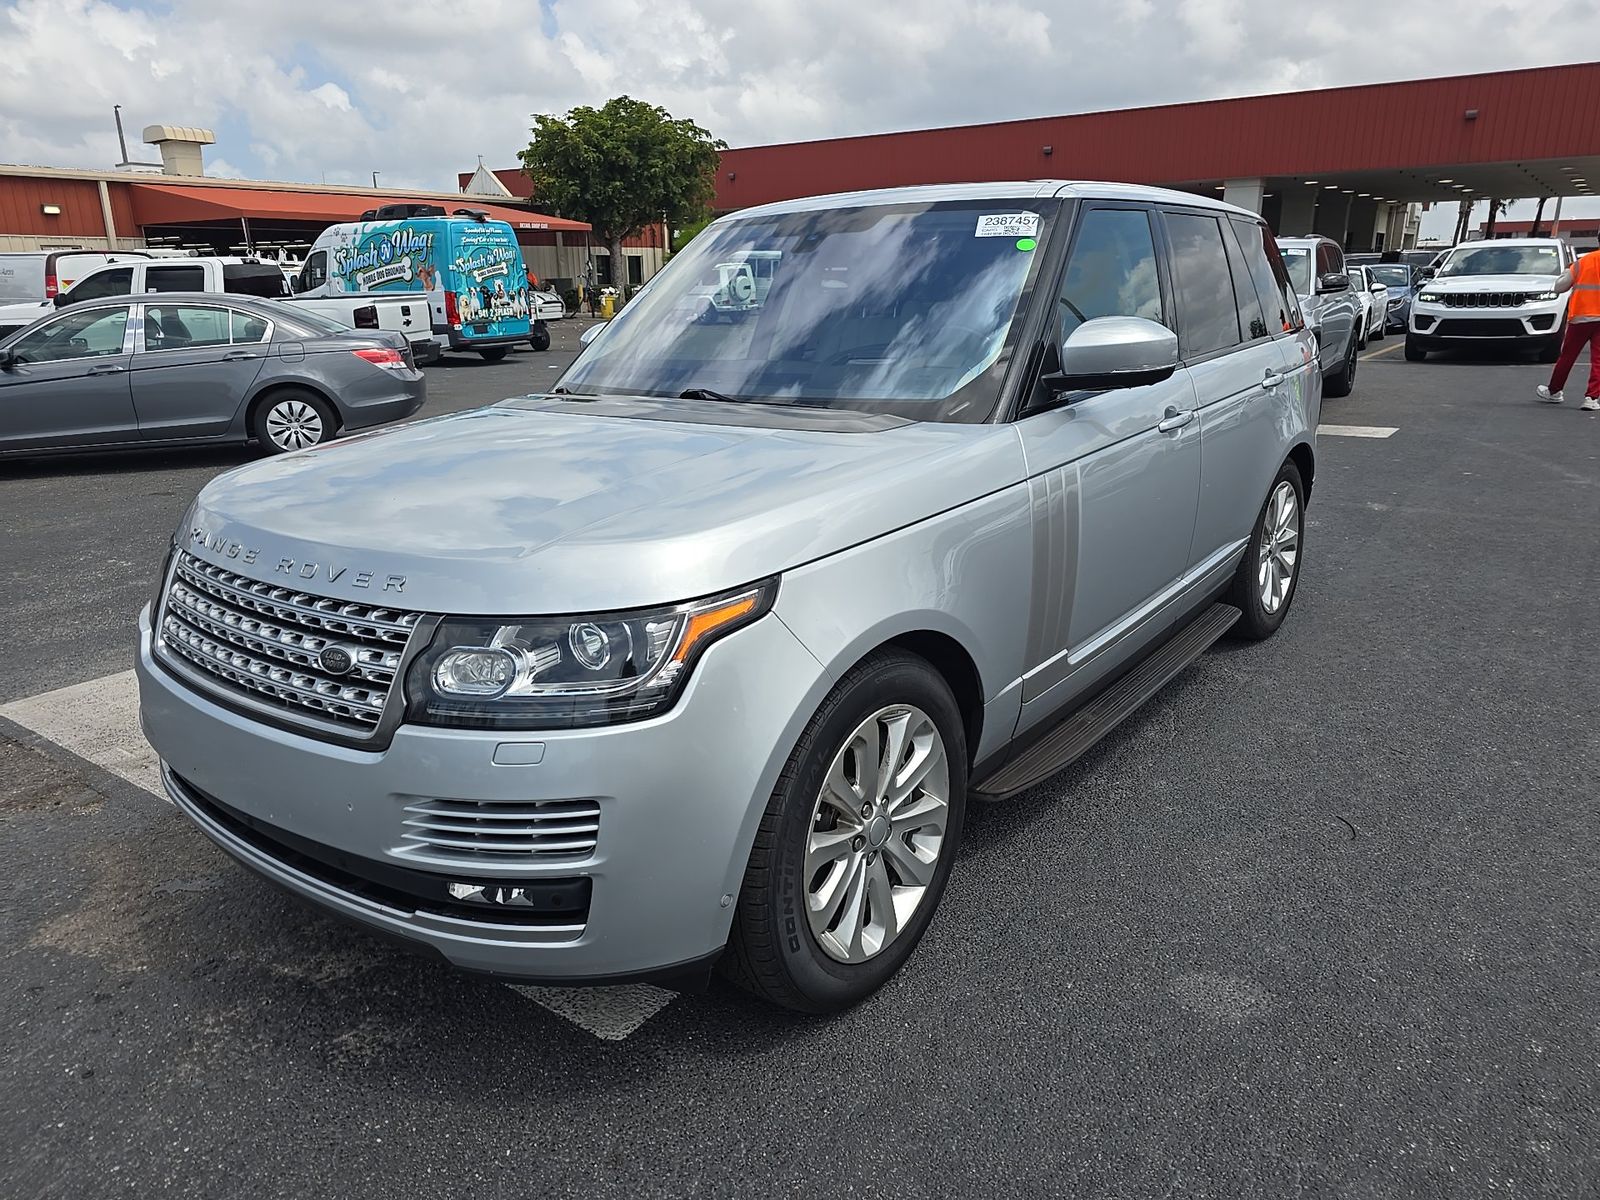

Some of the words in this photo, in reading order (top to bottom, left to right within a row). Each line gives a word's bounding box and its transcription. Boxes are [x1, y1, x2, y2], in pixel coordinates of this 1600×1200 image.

[984, 215, 1039, 226] 2387457
[336, 241, 380, 280] Splash
[456, 253, 488, 275] Splash
[362, 272, 377, 286] MOBILE
[376, 270, 385, 281] DOG
[385, 265, 406, 277] GROOMING
[189, 527, 260, 564] RANGE
[275, 556, 408, 593] ROVER
